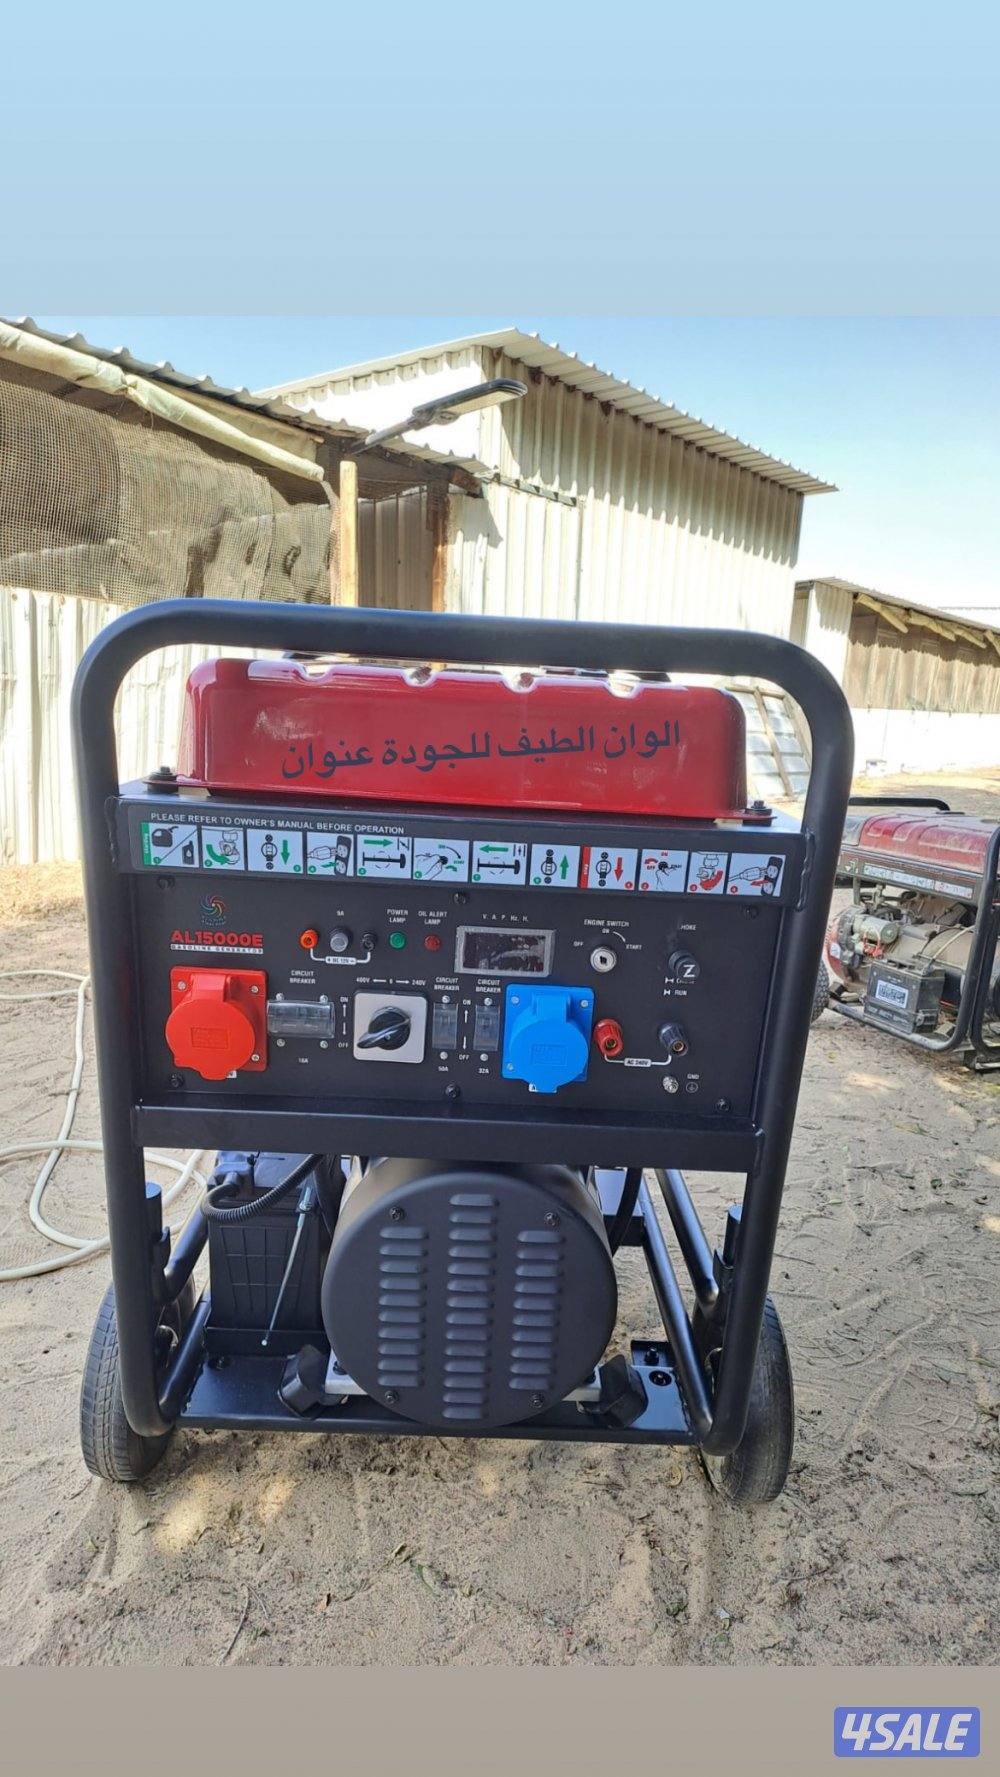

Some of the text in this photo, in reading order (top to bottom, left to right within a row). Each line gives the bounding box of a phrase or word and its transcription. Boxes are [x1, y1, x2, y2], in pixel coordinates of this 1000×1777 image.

[281, 720, 681, 779] الوان الطيف للجودة عنوان
[150, 812, 405, 836] PLEASE REFER TO OWNER'S MANUAL BEFORE OPERATION
[606, 920, 630, 928] SWITCH
[171, 930, 263, 947] AL15000E
[289, 977, 316, 985] BREAKER
[477, 978, 500, 986] CIRCUIT
